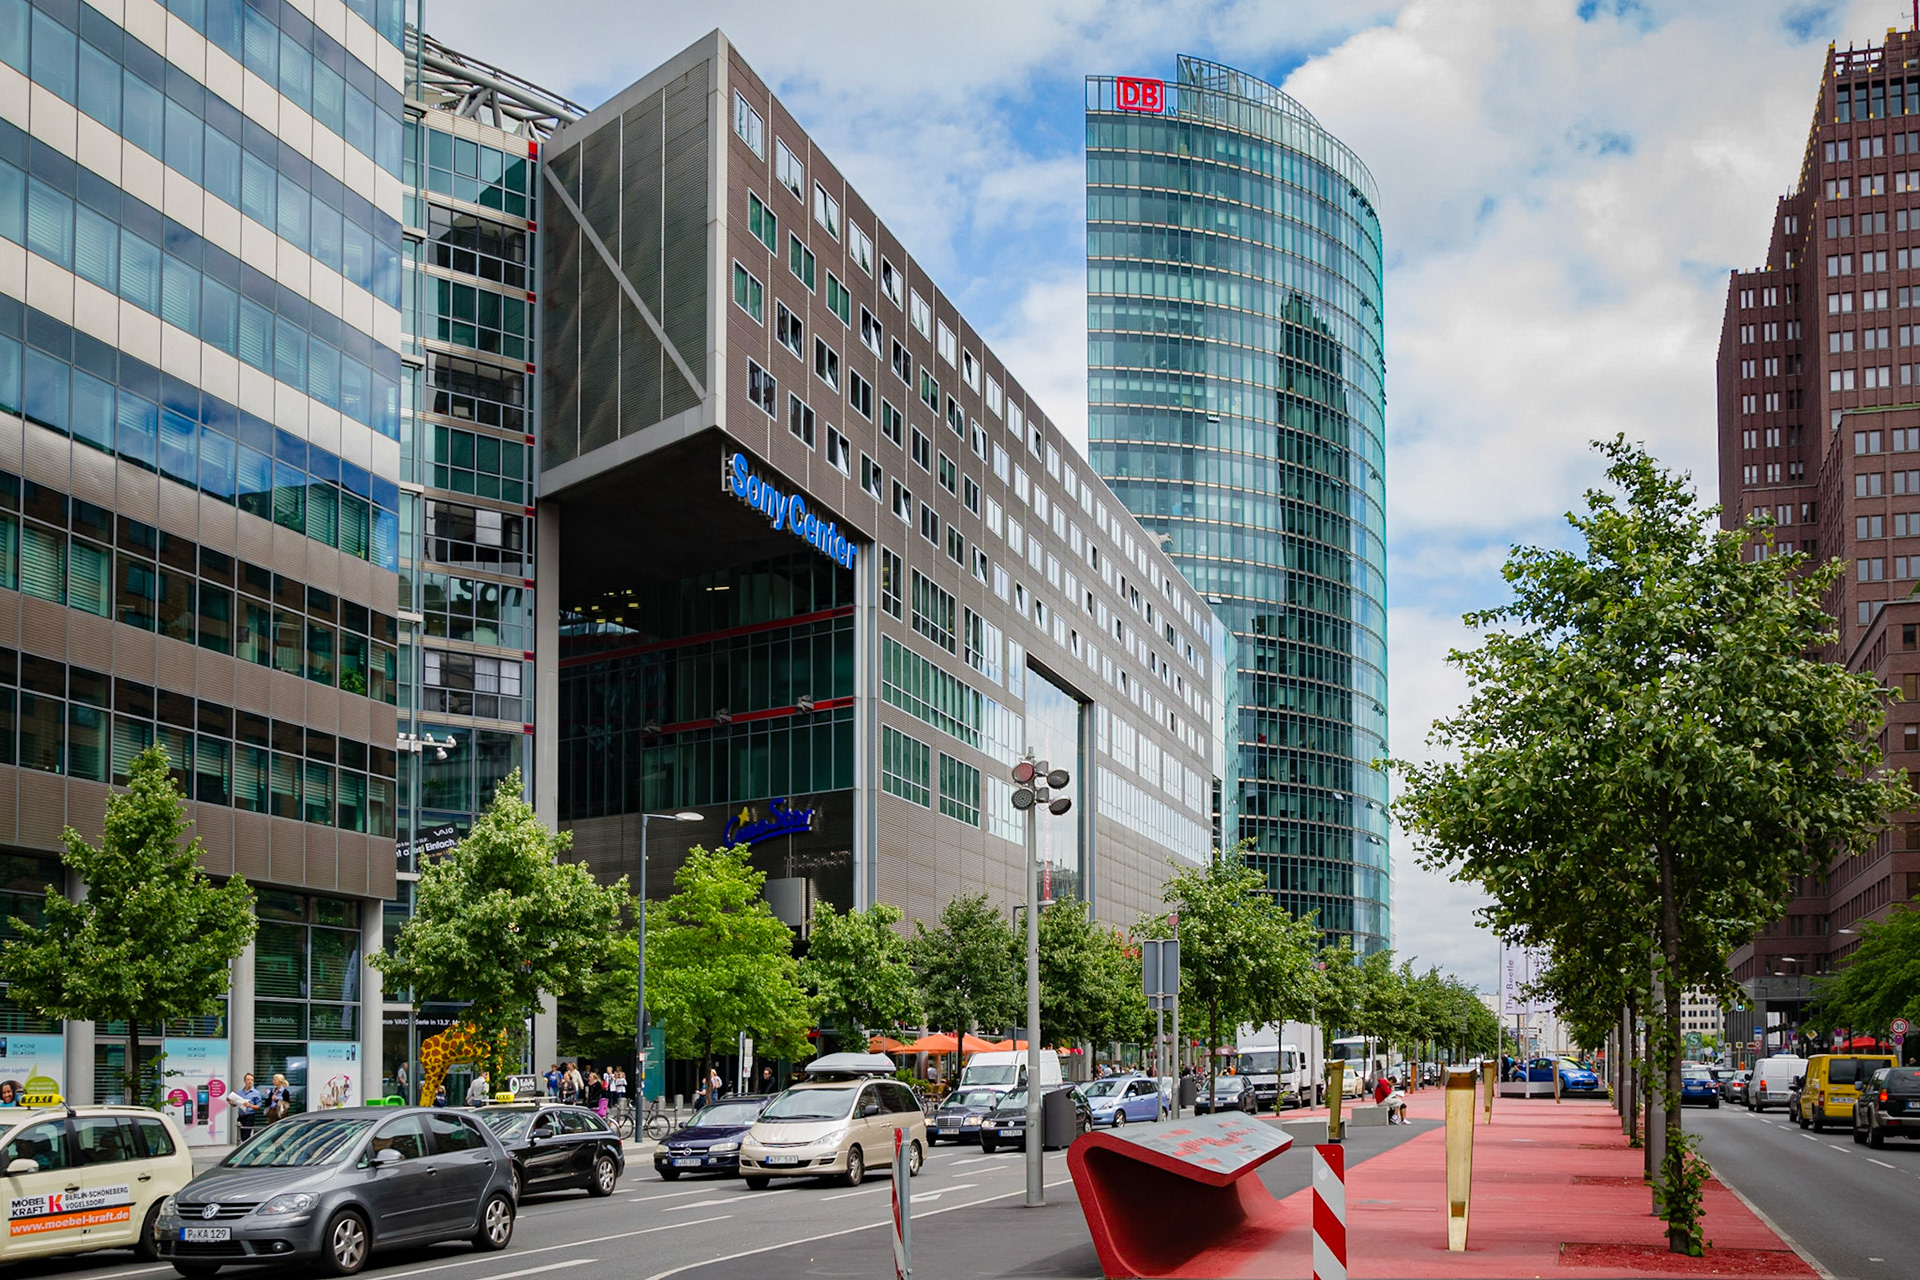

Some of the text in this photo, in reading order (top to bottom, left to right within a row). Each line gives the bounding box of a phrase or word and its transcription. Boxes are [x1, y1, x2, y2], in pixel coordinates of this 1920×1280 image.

[1122, 81, 1158, 107] DB
[729, 453, 858, 570] Sony Center
[433, 827, 454, 837] VAIO
[1506, 960, 1514, 989] Beetle
[1895, 1022, 1904, 1031] 30
[1689, 1034, 1699, 1045] S
[12, 1197, 46, 1208] MÖBEL
[66, 1198, 106, 1210] VOGELSDORF
[12, 1206, 44, 1217] KRAFT
[11, 1211, 129, 1233] www.moebel-kraft.de
[197, 1229, 209, 1239] KA
[210, 1229, 227, 1239] 129
